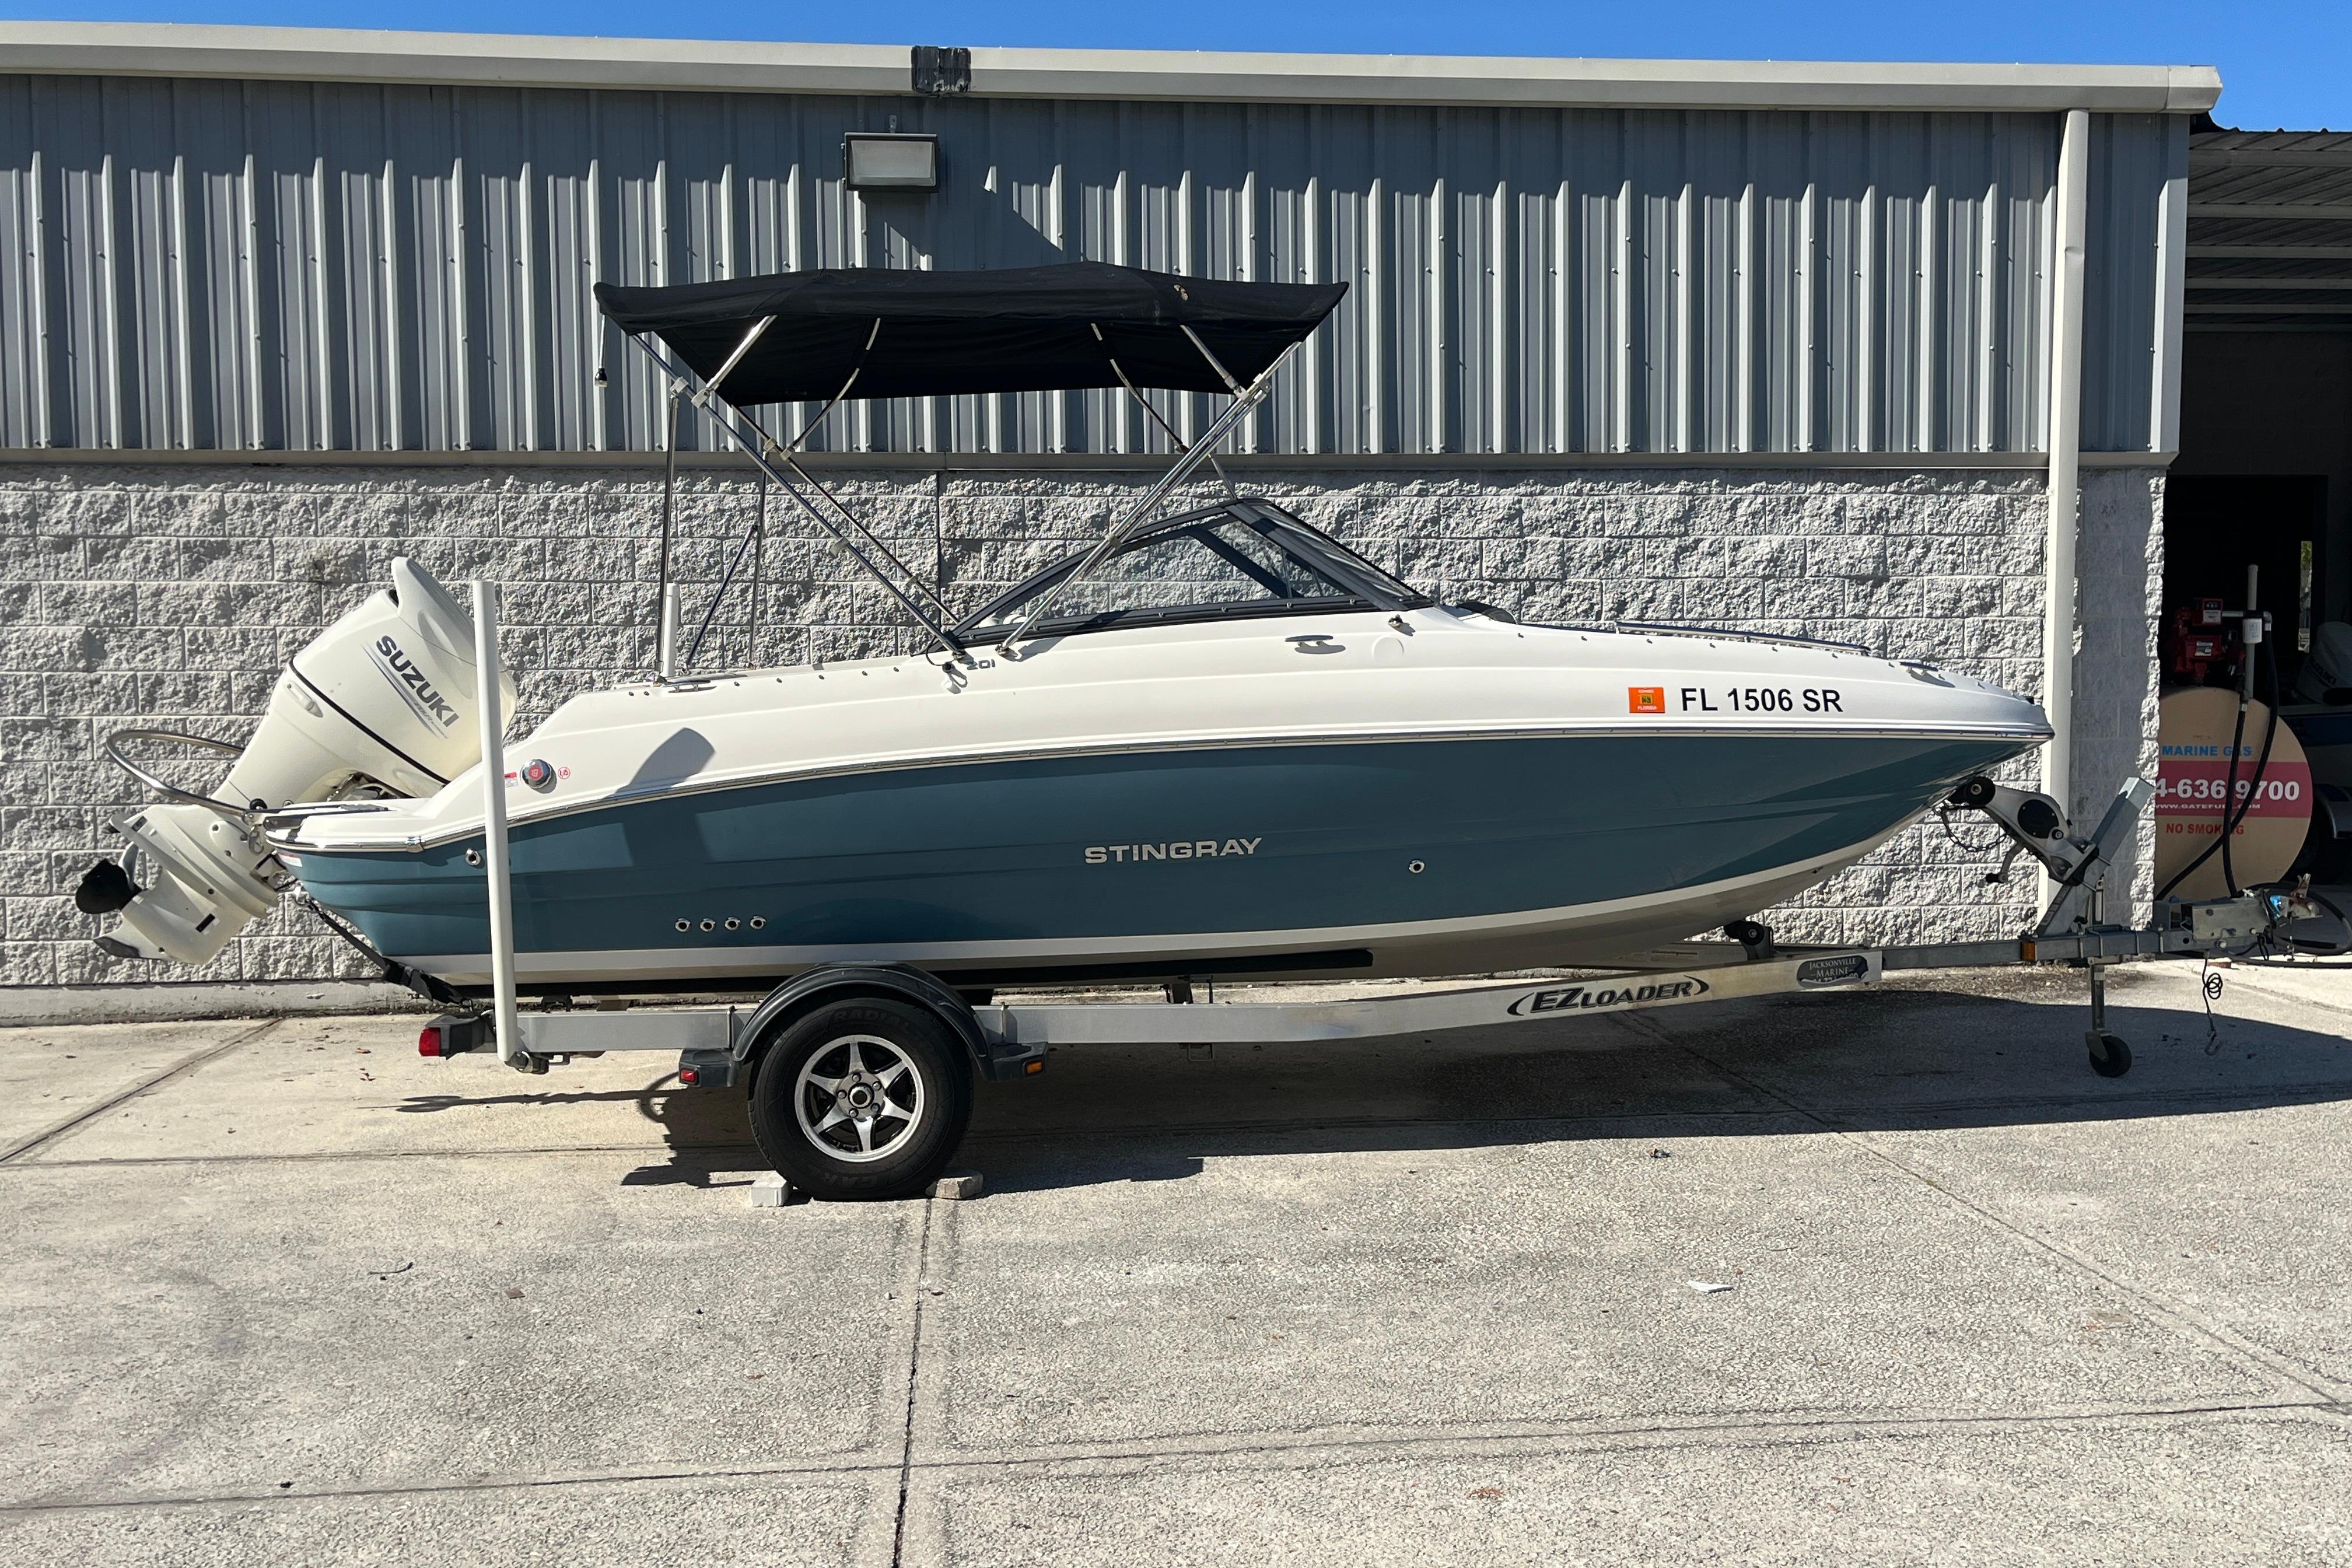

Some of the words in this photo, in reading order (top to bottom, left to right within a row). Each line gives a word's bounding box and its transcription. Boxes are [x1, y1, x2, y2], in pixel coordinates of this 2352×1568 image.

[376, 635, 460, 728] SUZUKI
[1681, 688, 1718, 712] FL
[1727, 688, 1793, 712] 1506
[1803, 689, 1843, 713] SR
[2162, 745, 2217, 757] MARINE
[2223, 746, 2253, 757] GS
[2166, 823, 2183, 834] NO
[2188, 824, 2245, 835] SMOKG
[1084, 837, 1262, 864] STINGRAY
[1809, 957, 1856, 970] JACKSONVILLE
[1816, 967, 1849, 978] MARINE
